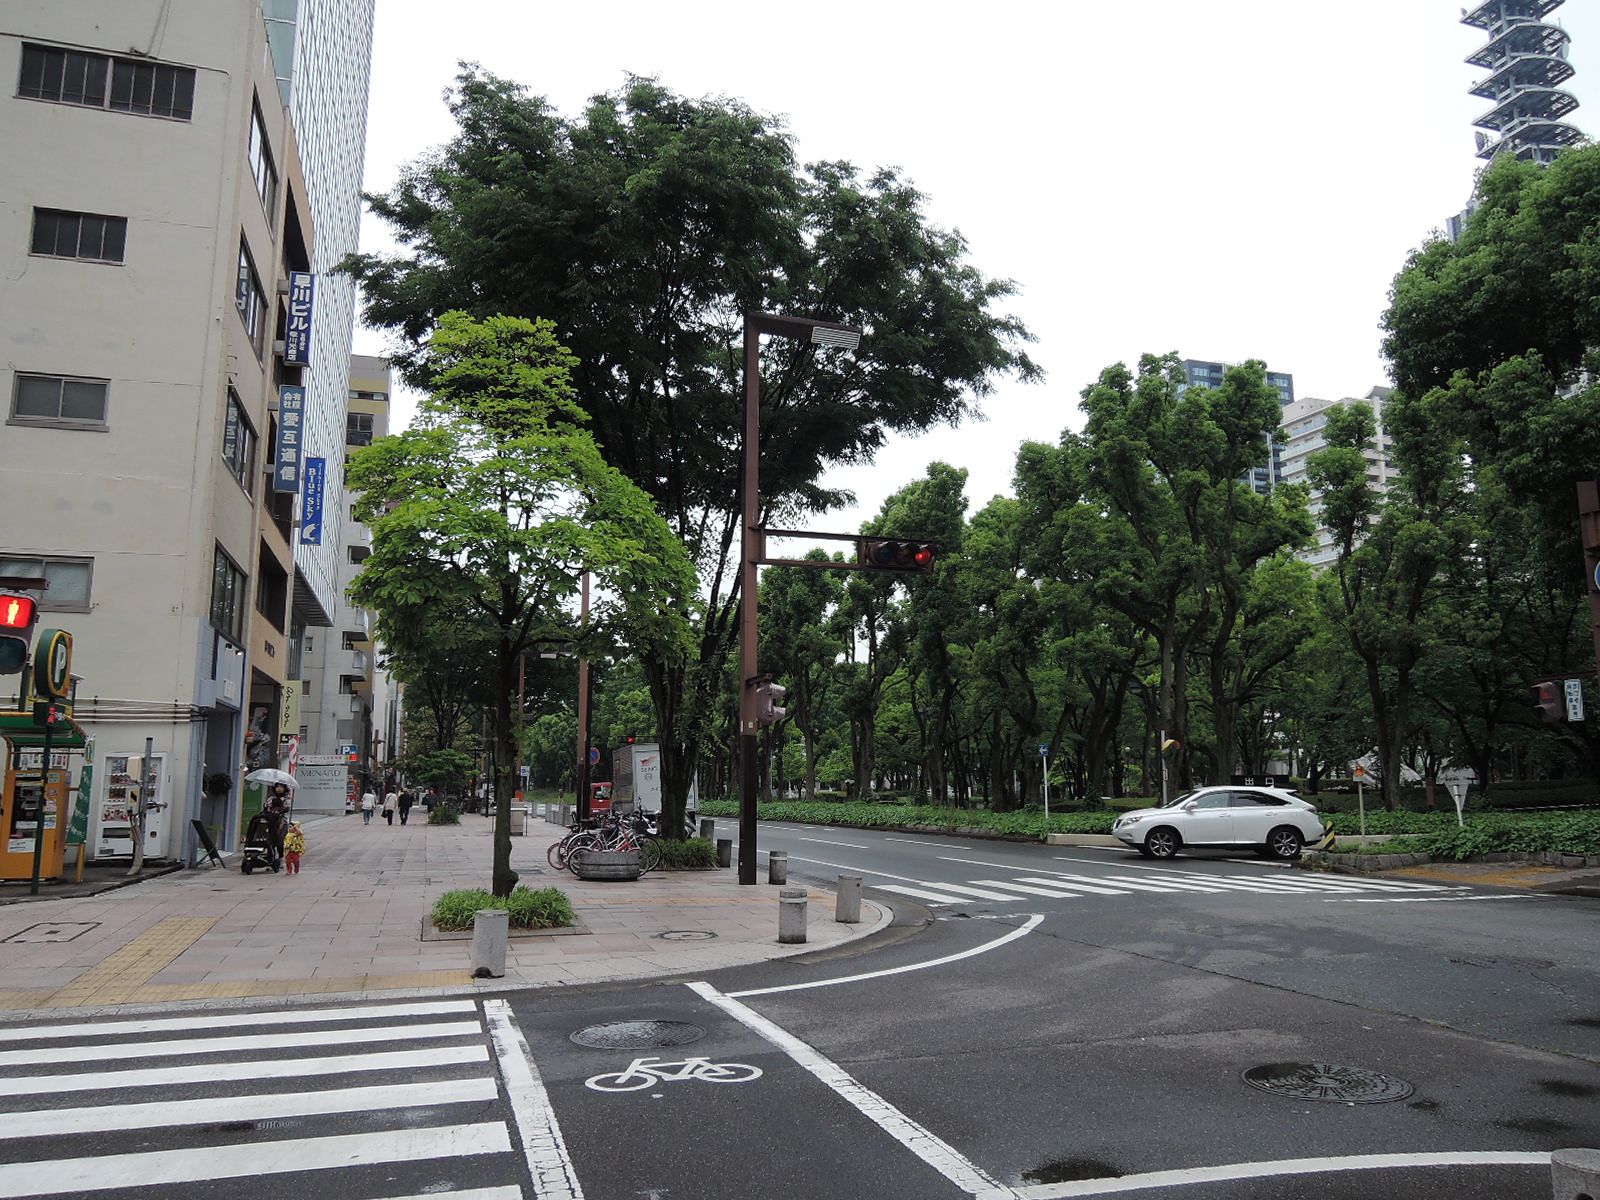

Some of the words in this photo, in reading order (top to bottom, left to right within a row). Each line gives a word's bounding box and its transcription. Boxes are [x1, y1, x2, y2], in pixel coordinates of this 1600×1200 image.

[279, 412, 299, 481] 愛互通信
[307, 467, 317, 495] Blue
[306, 497, 315, 520] Sky
[54, 643, 67, 684] P
[299, 769, 341, 777] MENARD
[1244, 777, 1275, 786] 出口
